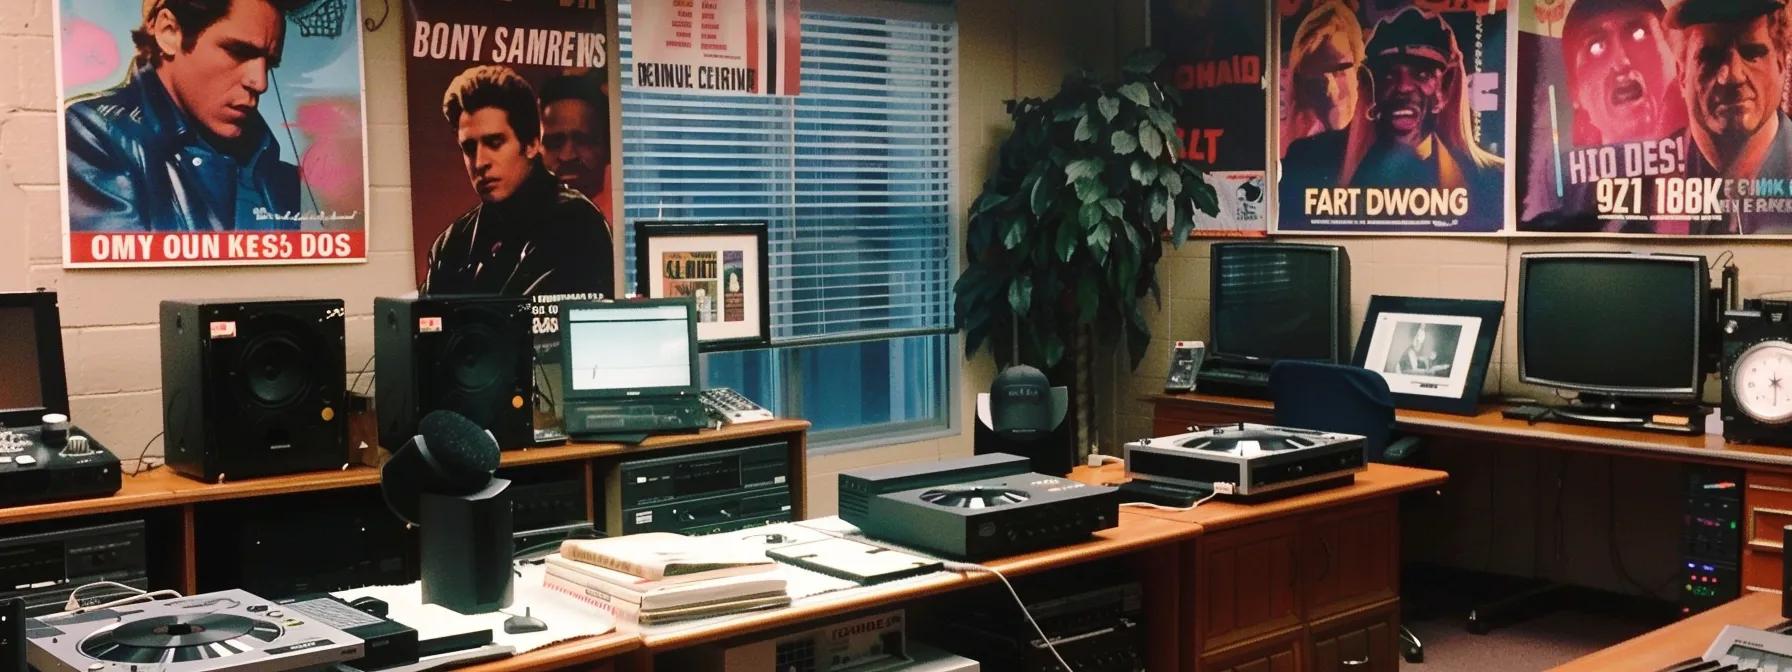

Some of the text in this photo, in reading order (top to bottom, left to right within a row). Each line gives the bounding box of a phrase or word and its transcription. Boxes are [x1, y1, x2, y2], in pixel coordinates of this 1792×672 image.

[413, 21, 487, 62] BONY
[1624, 136, 1686, 178] DES!
[1305, 187, 1469, 216] FART DWONG
[91, 234, 153, 261] OMY
[163, 234, 220, 260] OUN
[301, 233, 352, 258] DOS
